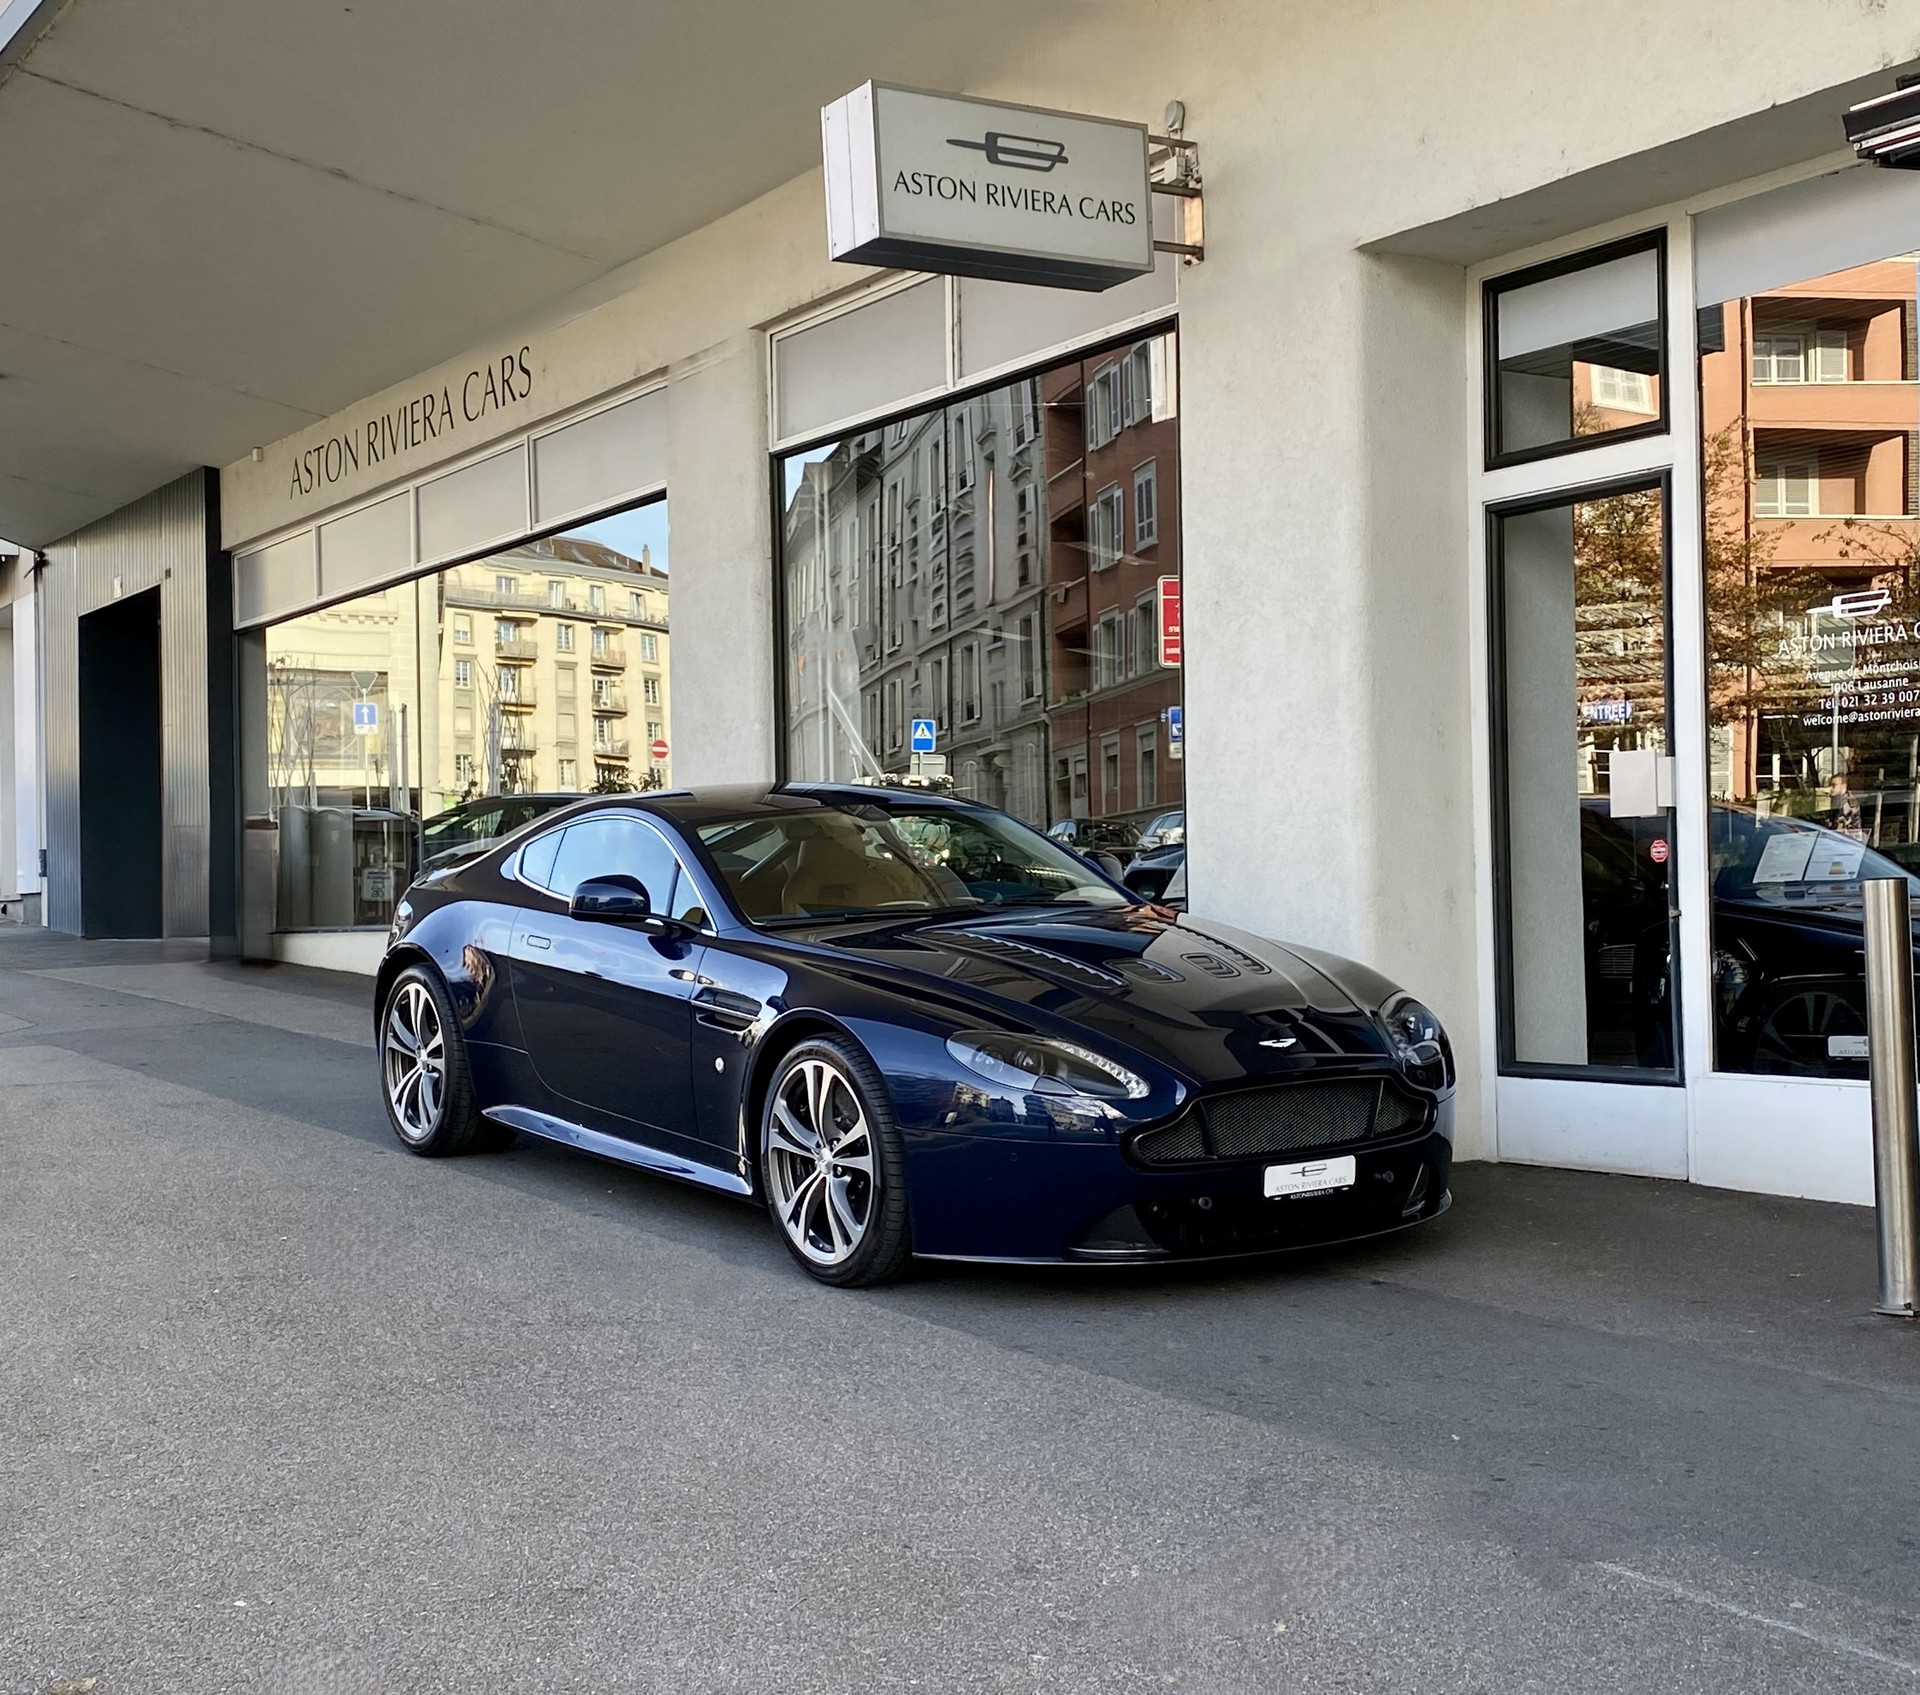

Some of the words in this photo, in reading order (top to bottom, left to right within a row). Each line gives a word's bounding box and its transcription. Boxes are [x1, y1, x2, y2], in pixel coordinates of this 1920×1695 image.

[893, 170, 977, 203] ASTON
[986, 183, 1073, 217] RIVIERA
[1079, 197, 1136, 225] CARS
[290, 429, 359, 500] ASTON
[367, 386, 455, 467] RIVIERA
[462, 345, 532, 422] CARS
[1778, 633, 1835, 655] ASTON
[1841, 624, 1908, 648] RIVIERA
[1806, 668, 1844, 681] Avenue
[1847, 665, 1860, 677] de
[1857, 677, 1909, 691] Lausanne
[1841, 695, 1859, 708] 021
[1863, 694, 1878, 706] 32
[1881, 692, 1895, 704] 39
[1898, 689, 1920, 703] 007
[1275, 1183, 1300, 1193] ASTON
[1301, 1179, 1328, 1190] RIVIERA
[1328, 1176, 1347, 1186] CARS
